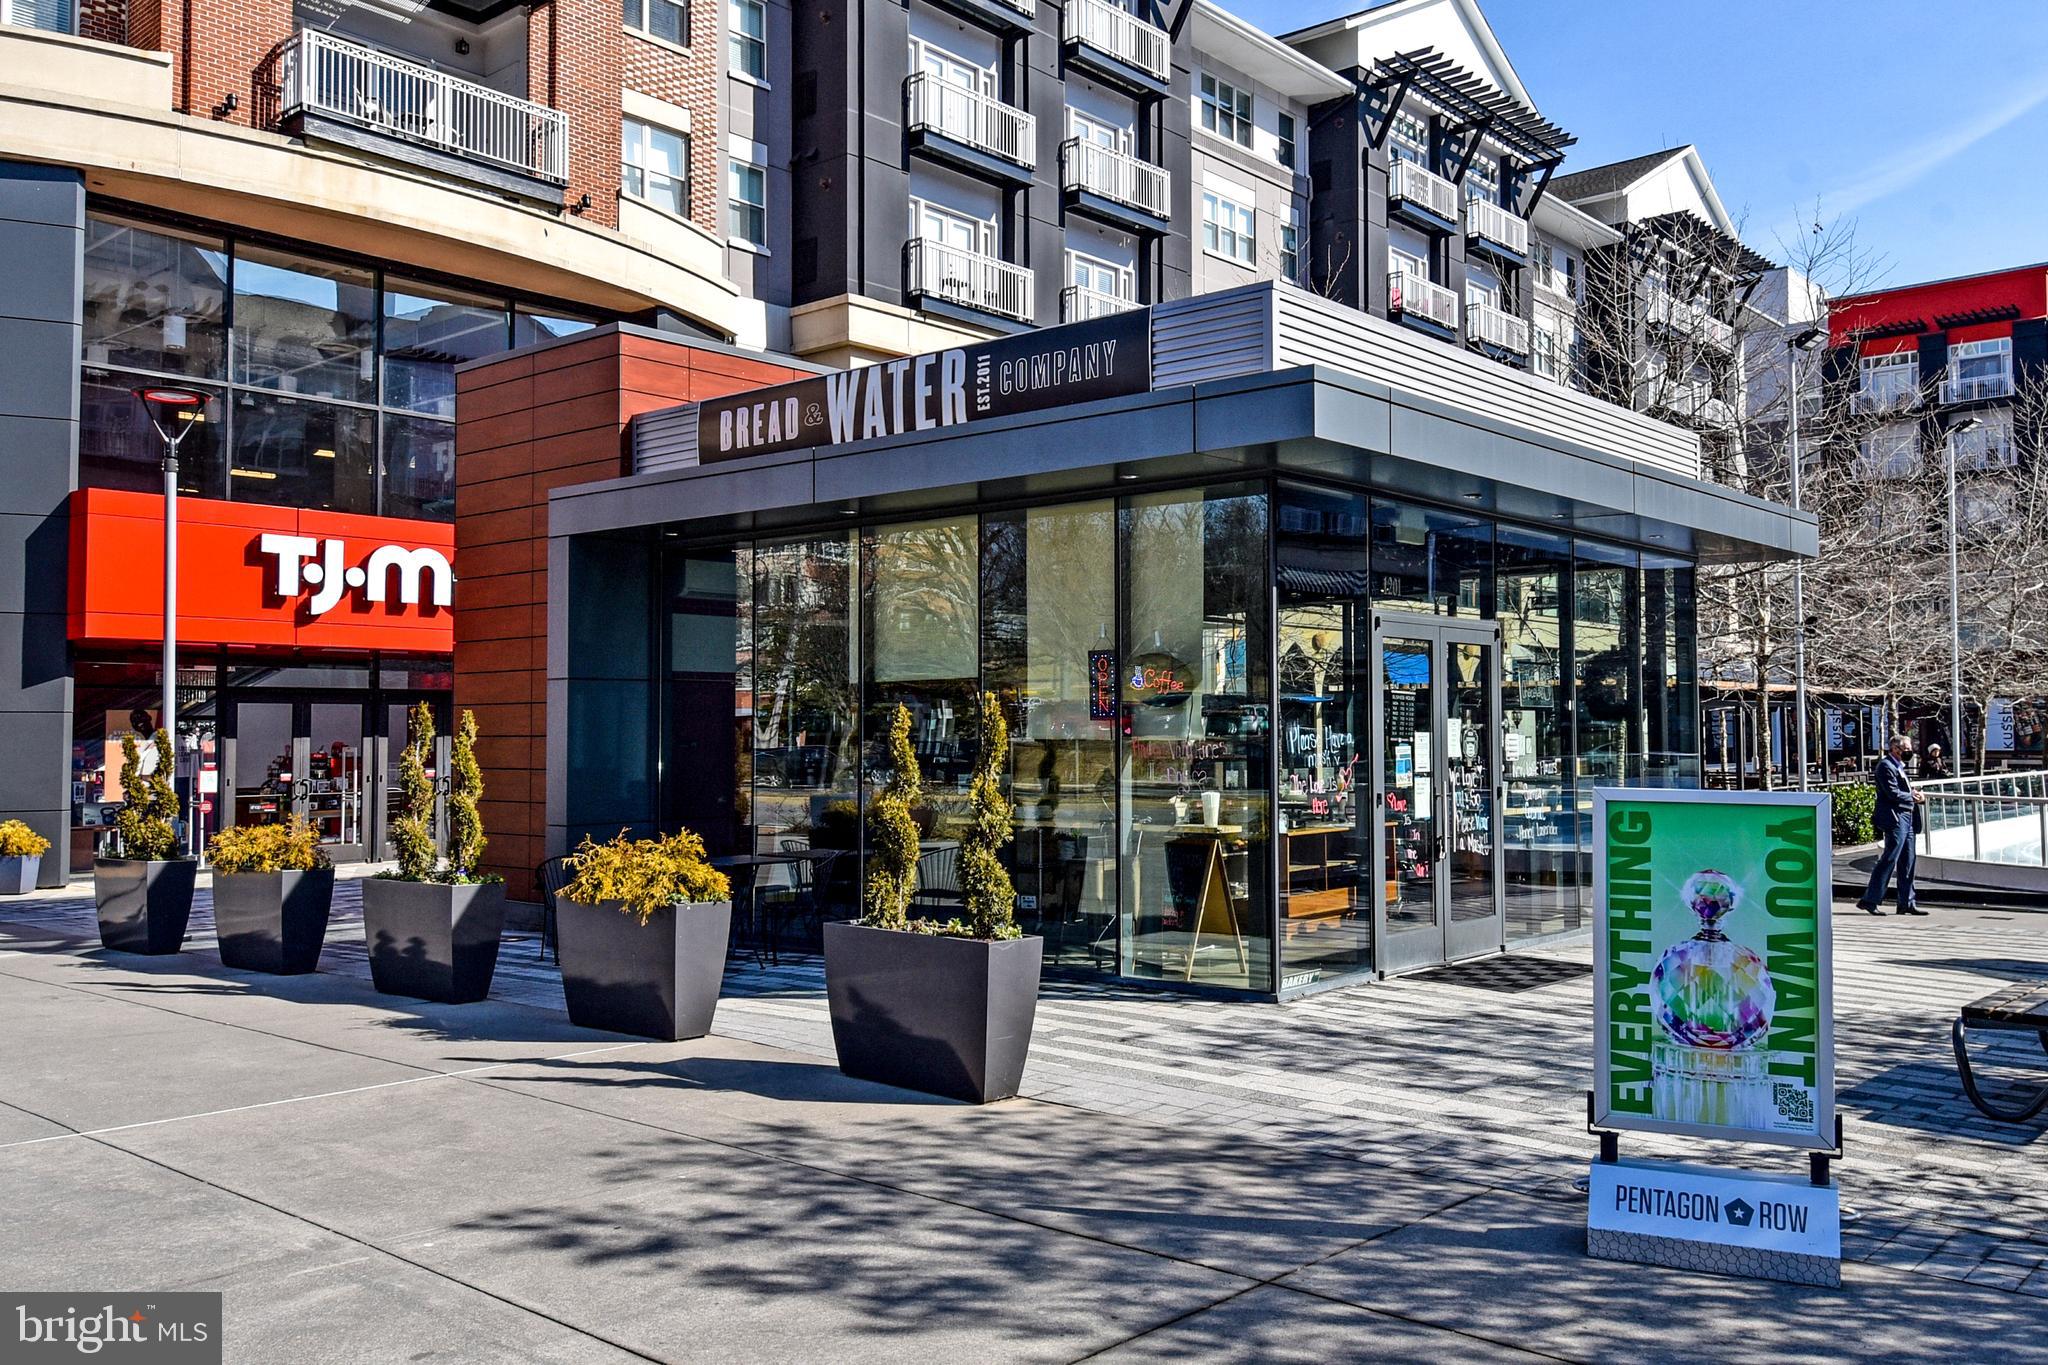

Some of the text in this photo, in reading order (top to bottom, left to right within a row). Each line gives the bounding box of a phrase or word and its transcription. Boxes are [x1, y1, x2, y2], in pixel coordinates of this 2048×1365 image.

[719, 339, 1118, 453] BREAD & WATER EST.2011 COMPANY
[1097, 657, 1109, 713] OPEN
[1144, 668, 1184, 694] Coffee
[1288, 724, 1320, 754] Please
[1325, 725, 1344, 754] Have
[1289, 774, 1307, 794] The
[1448, 766, 1477, 788] We Love
[1311, 797, 1329, 815] Here
[1765, 815, 1814, 920] YOU
[1608, 810, 1652, 1114] EVERYTHING
[1766, 931, 1816, 1087] WANT
[1616, 1184, 1808, 1234] PENTAGON ROW
